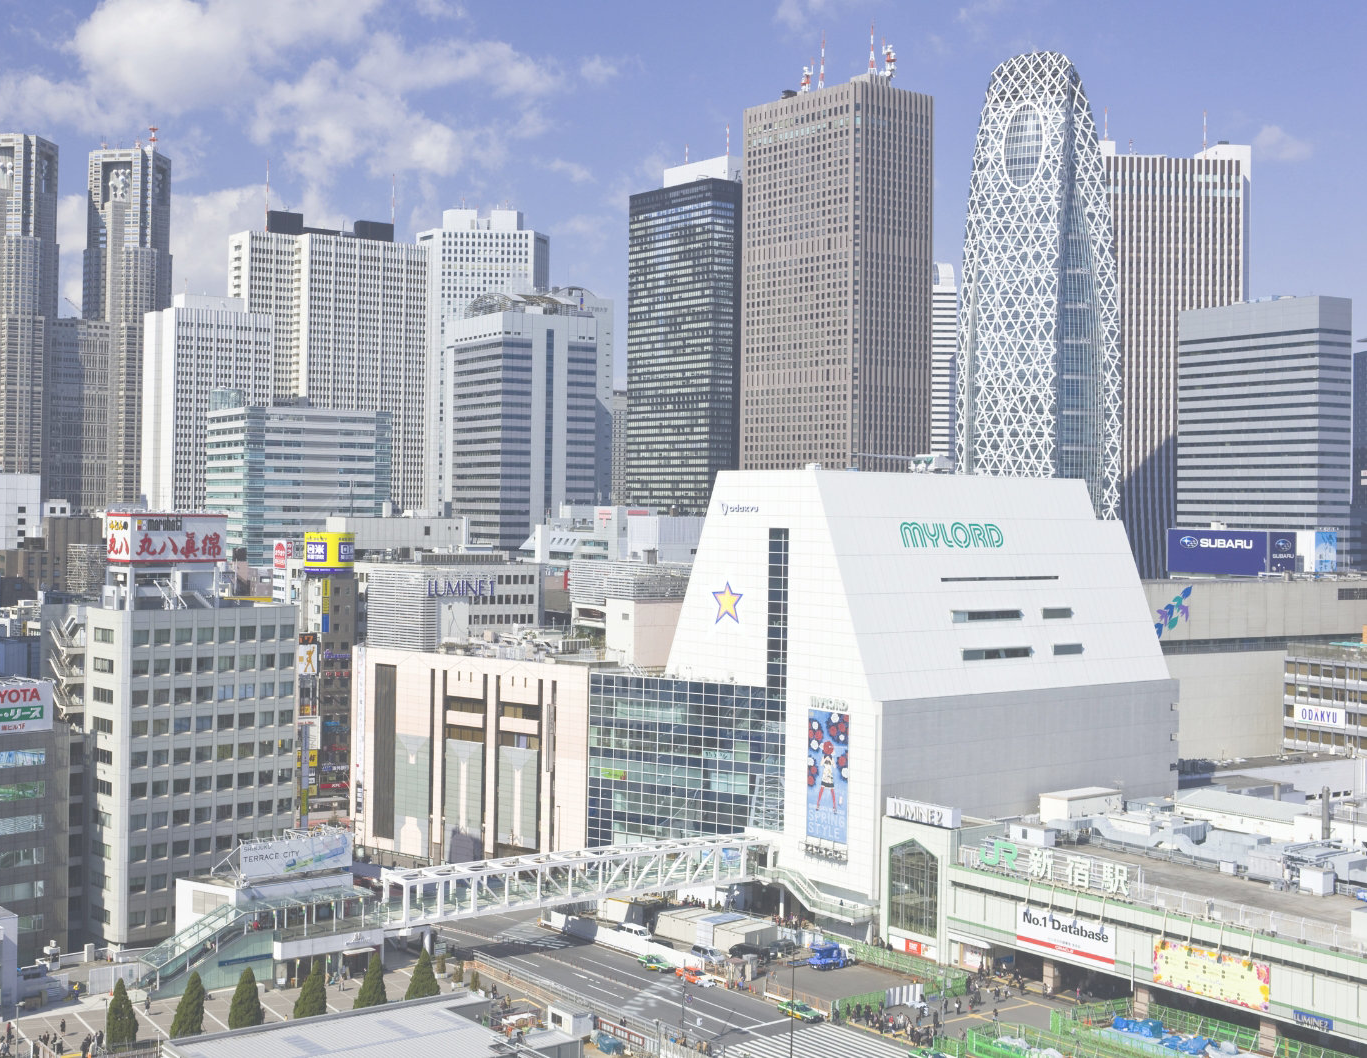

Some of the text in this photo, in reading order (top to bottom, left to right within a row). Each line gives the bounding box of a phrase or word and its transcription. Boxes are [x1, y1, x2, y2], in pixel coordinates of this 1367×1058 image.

[899, 521, 1004, 549] MYLORD
[1199, 538, 1253, 549] SUBARU
[1301, 707, 1338, 724] ODAKYU
[808, 809, 845, 828] SPRING
[808, 821, 840, 840] STYLE
[243, 850, 300, 863] TERRACE CITY
[980, 840, 1129, 897] JR 新宿駅
[1022, 911, 1109, 943] No.1 Database
